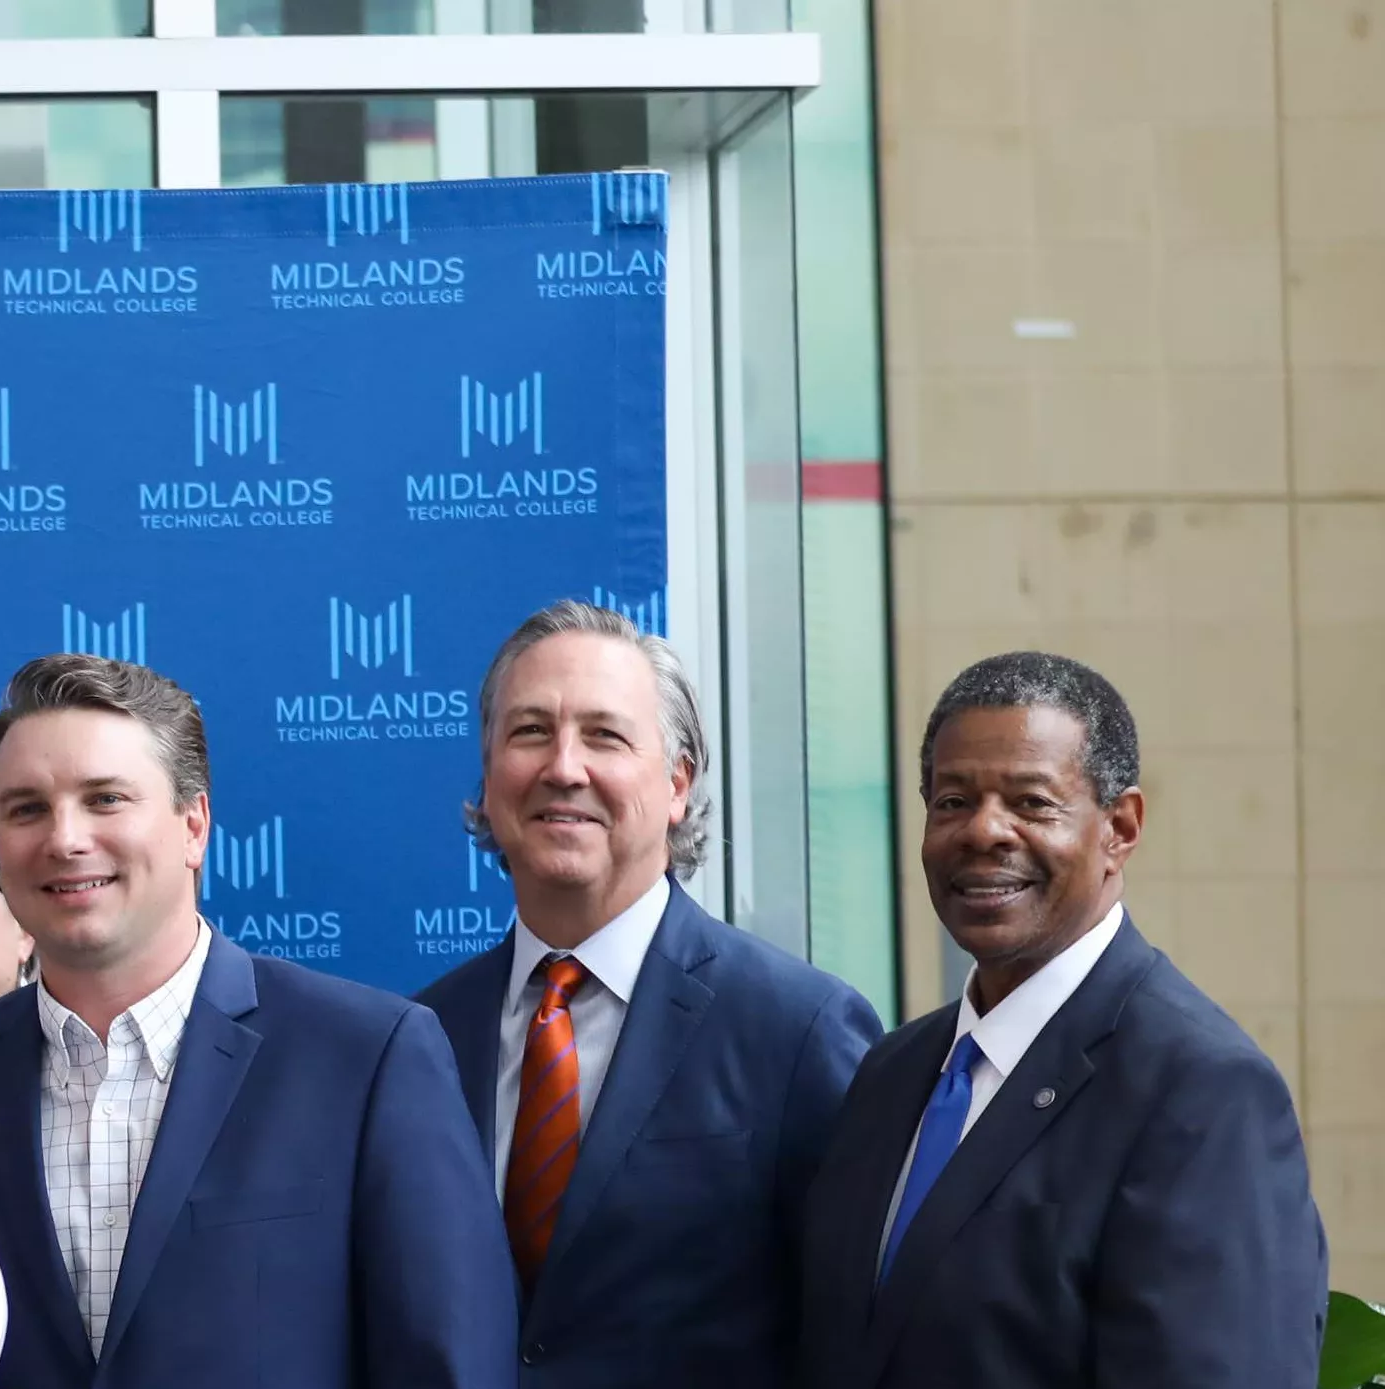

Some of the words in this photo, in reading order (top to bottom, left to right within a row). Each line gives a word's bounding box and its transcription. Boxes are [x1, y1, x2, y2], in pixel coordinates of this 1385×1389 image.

[3, 265, 198, 295] MIDLANDS
[271, 256, 465, 291] MIDLANDS
[271, 292, 375, 310] TECHNICAL
[380, 287, 465, 306] COLLEGE
[537, 280, 639, 299] TECHNICAL
[3, 299, 107, 315] TECHNICAL
[113, 297, 198, 314] COLLEGE
[139, 477, 333, 510] MIDLANDS
[406, 467, 598, 502] MIDLANDS
[140, 512, 243, 530] TECHNICAL
[248, 509, 333, 526] COLLEGE
[406, 503, 509, 521] TECHNICAL
[514, 498, 598, 517] COLLEGE
[276, 690, 469, 723] MIDLANDS
[276, 725, 379, 742] TECHNICAL
[385, 721, 469, 739] COLLEGE
